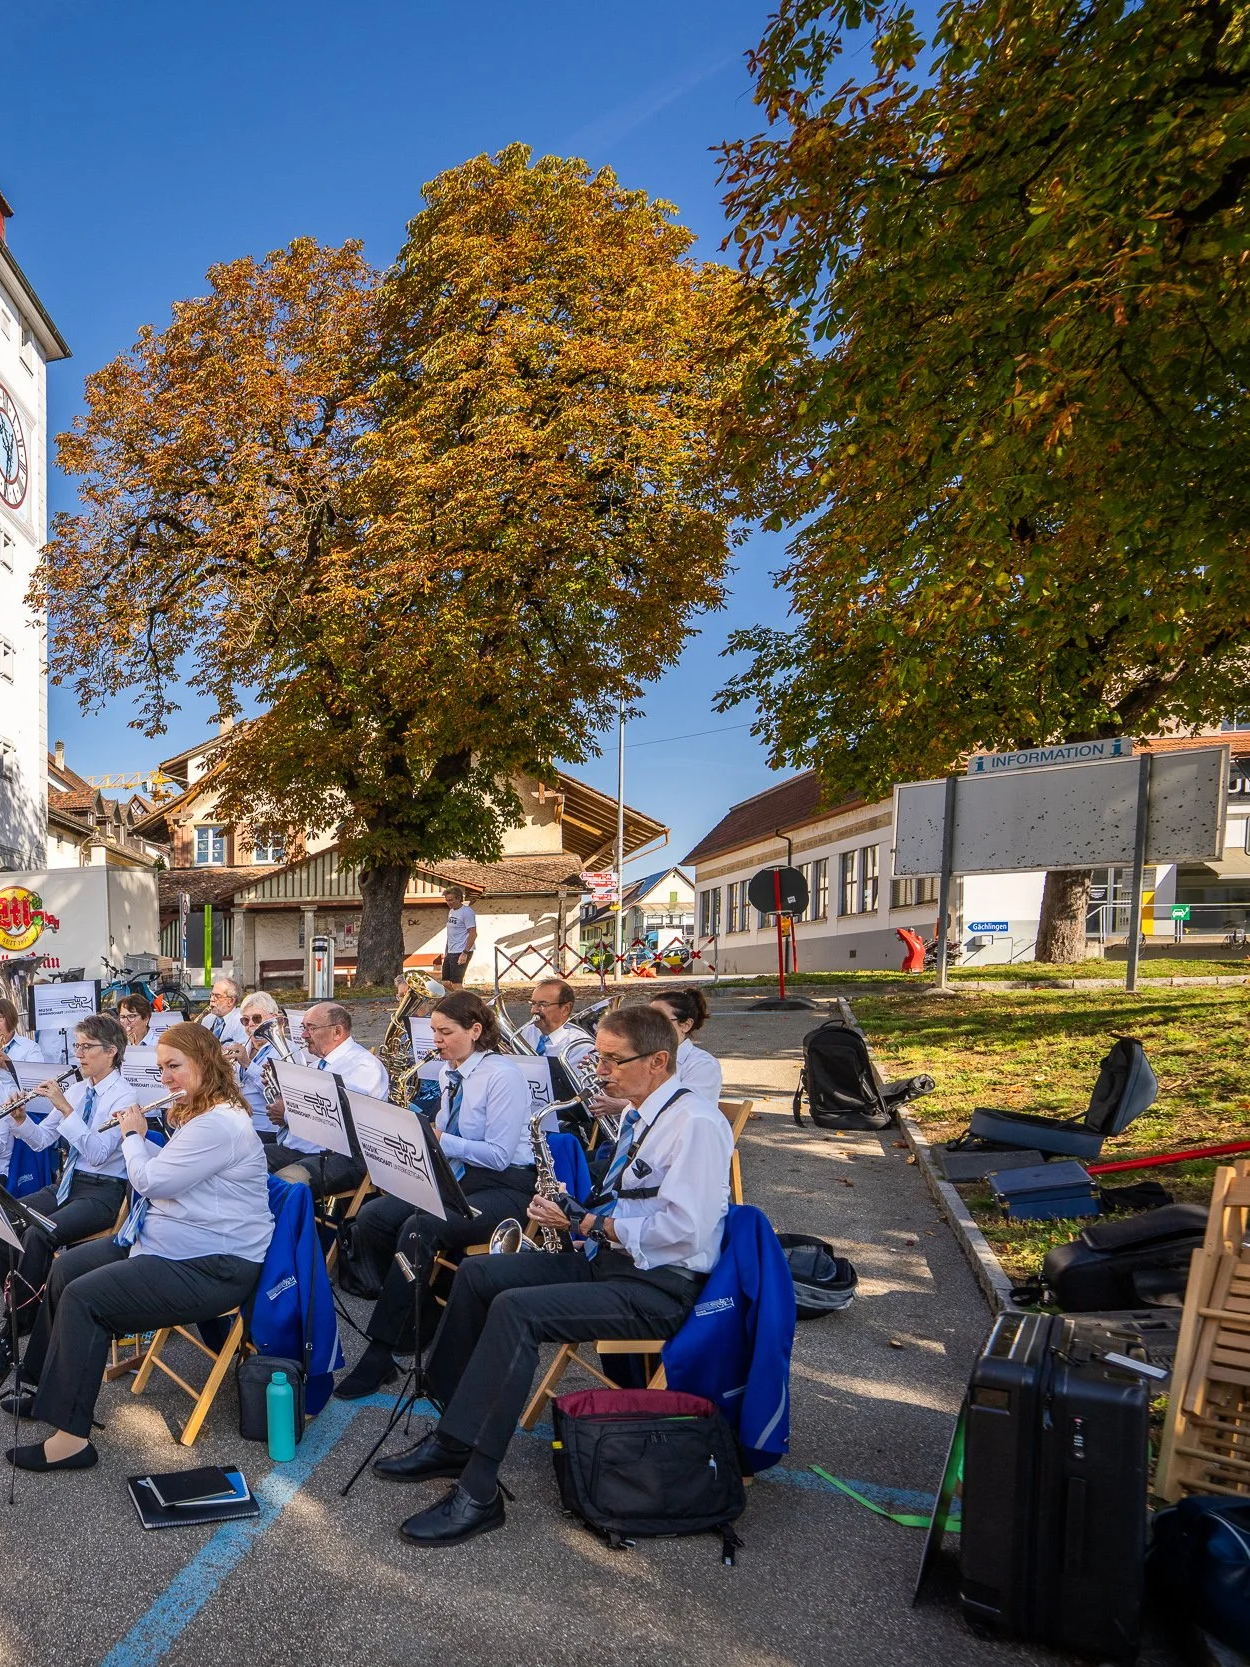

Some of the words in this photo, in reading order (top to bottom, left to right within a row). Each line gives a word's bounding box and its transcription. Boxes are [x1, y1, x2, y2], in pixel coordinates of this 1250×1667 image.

[992, 743, 1104, 768] INFORMATION
[972, 922, 1008, 932] Gächlingen
[361, 1141, 380, 1156] MUSIK
